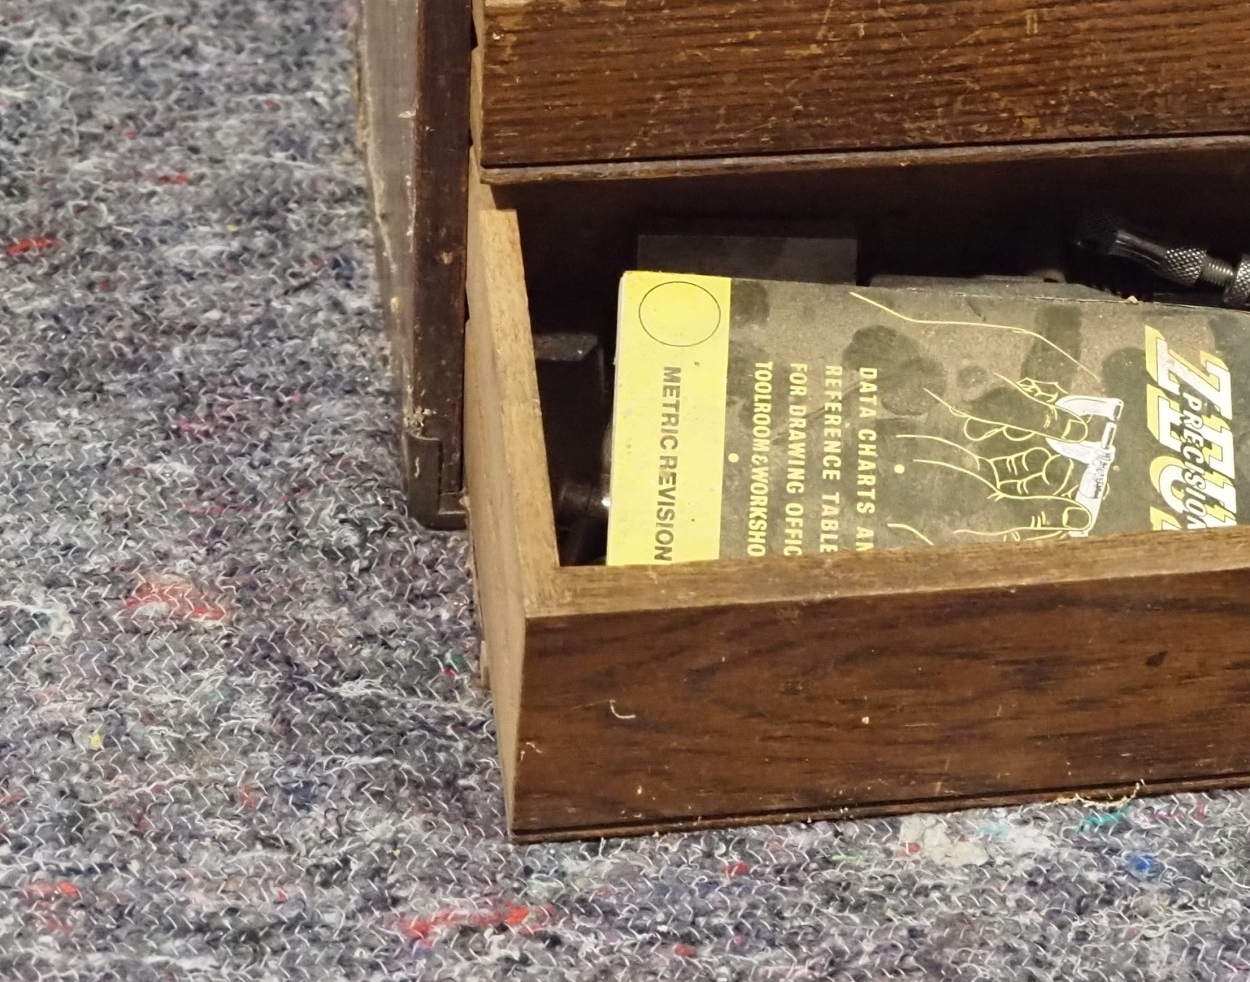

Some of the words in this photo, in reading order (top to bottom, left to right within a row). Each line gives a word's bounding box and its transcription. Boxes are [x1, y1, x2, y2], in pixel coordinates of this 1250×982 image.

[659, 366, 681, 450] METRIC
[752, 361, 774, 452] TOOLROOM
[789, 362, 808, 396] FOR
[859, 367, 878, 418] DATA
[786, 404, 807, 494] DRAWING
[822, 365, 843, 481] REFERENCE
[654, 455, 678, 561] REVISION
[856, 429, 878, 514] CHARTS
